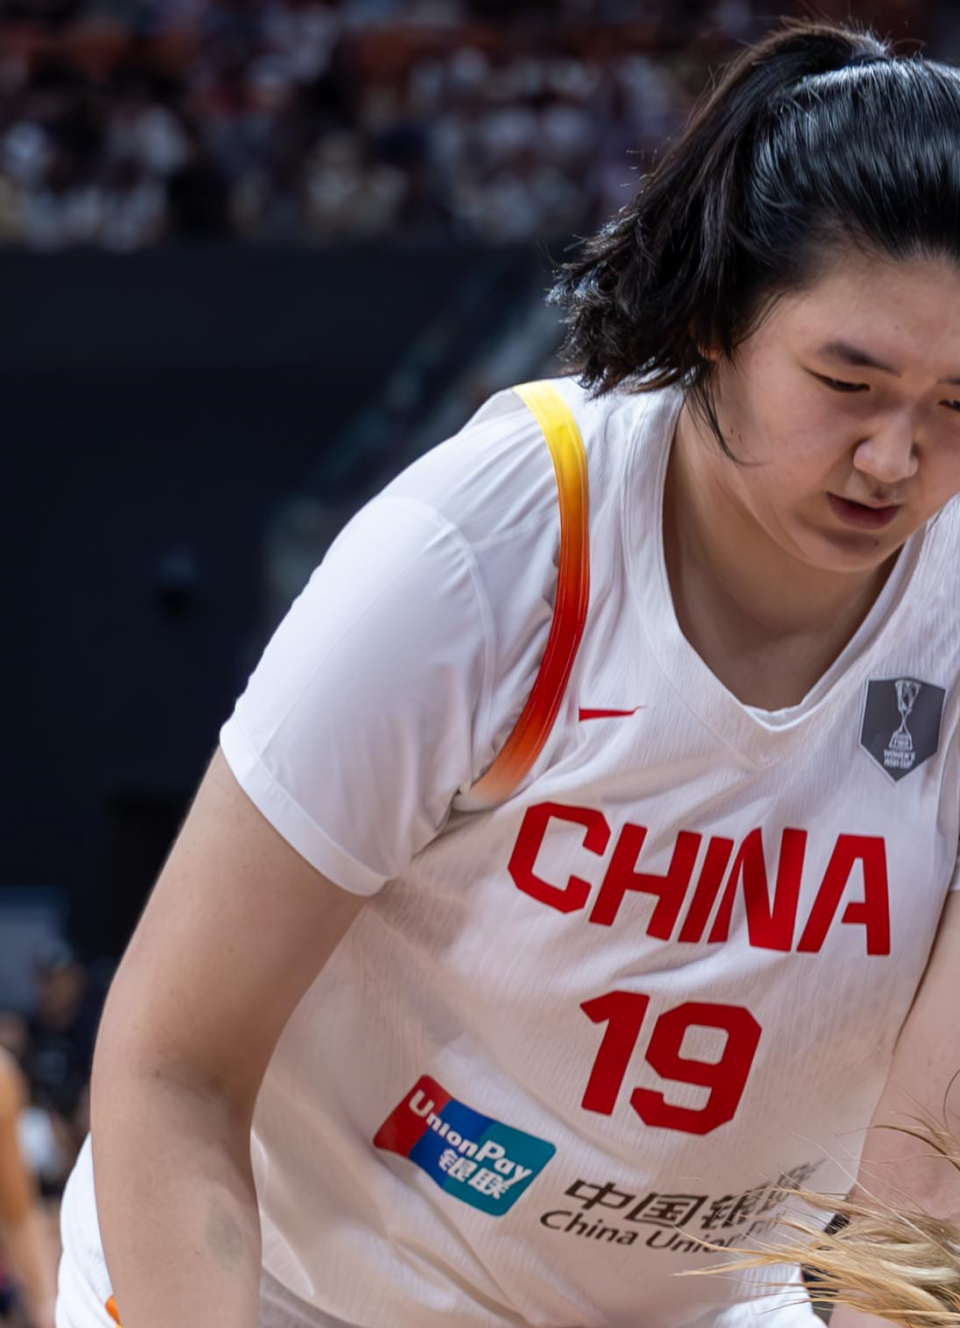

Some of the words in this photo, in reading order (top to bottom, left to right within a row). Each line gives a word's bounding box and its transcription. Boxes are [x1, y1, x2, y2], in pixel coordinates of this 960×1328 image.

[508, 802, 891, 956] CHINA
[580, 990, 763, 1136] 19
[408, 1088, 533, 1188] UnionPay
[438, 1148, 510, 1200] 银联
[539, 1209, 639, 1247] China
